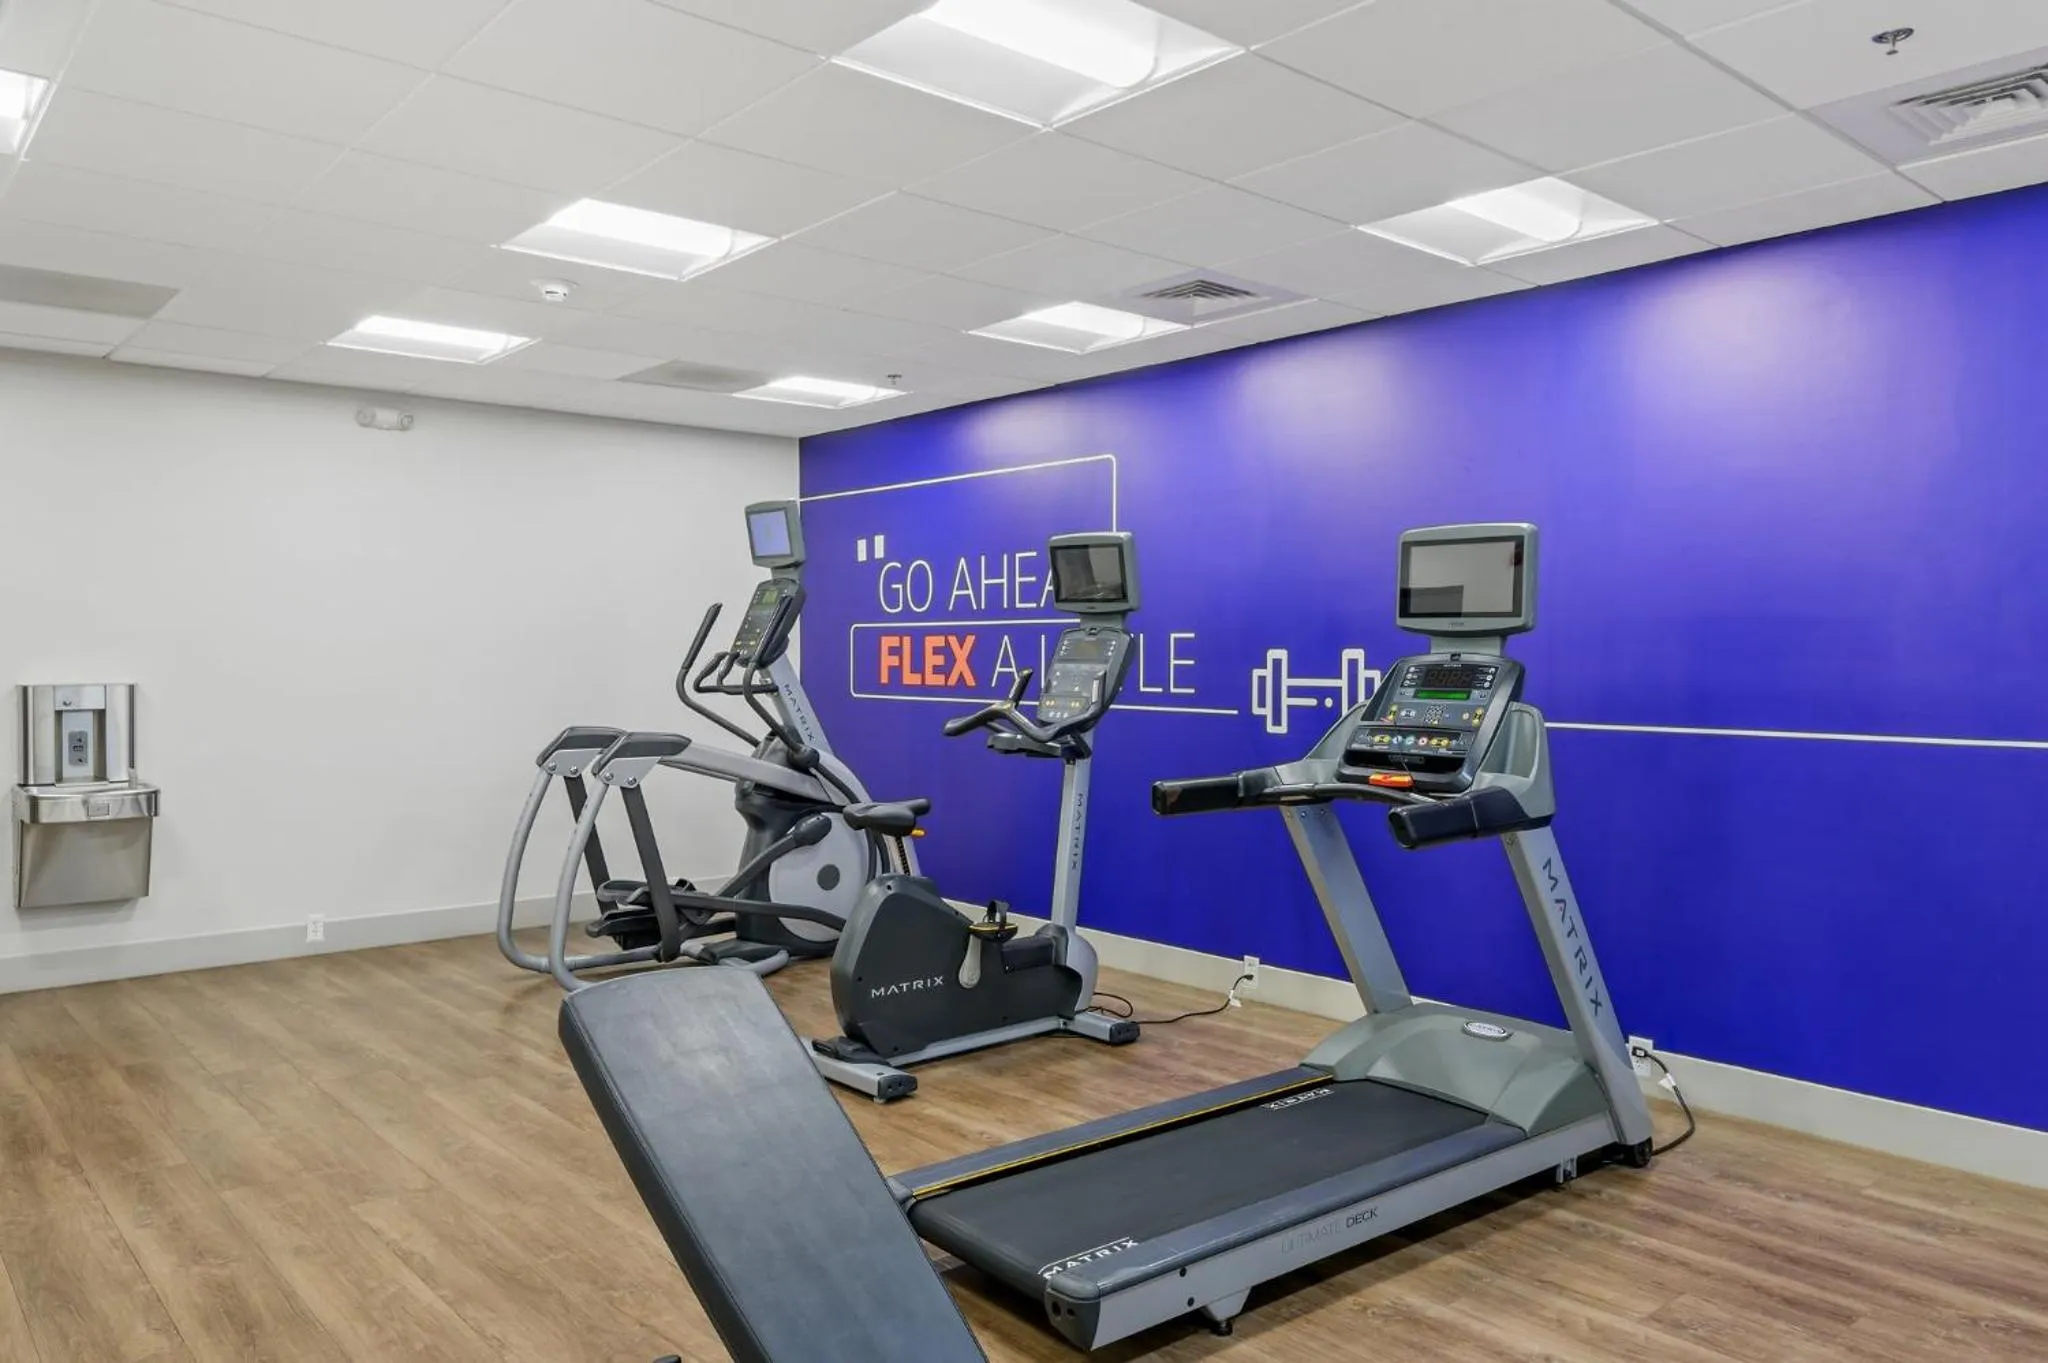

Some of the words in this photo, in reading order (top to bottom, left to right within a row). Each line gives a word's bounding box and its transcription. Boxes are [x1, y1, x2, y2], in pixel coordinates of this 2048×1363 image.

[879, 634, 976, 687] FLEX
[991, 634, 1018, 688] A
[783, 683, 815, 742] MATRIX
[1542, 857, 1602, 1017] MATRIX
[871, 975, 944, 998] MATRIX
[1345, 1205, 1379, 1229] DECK
[1042, 1239, 1139, 1280] MATRIX
